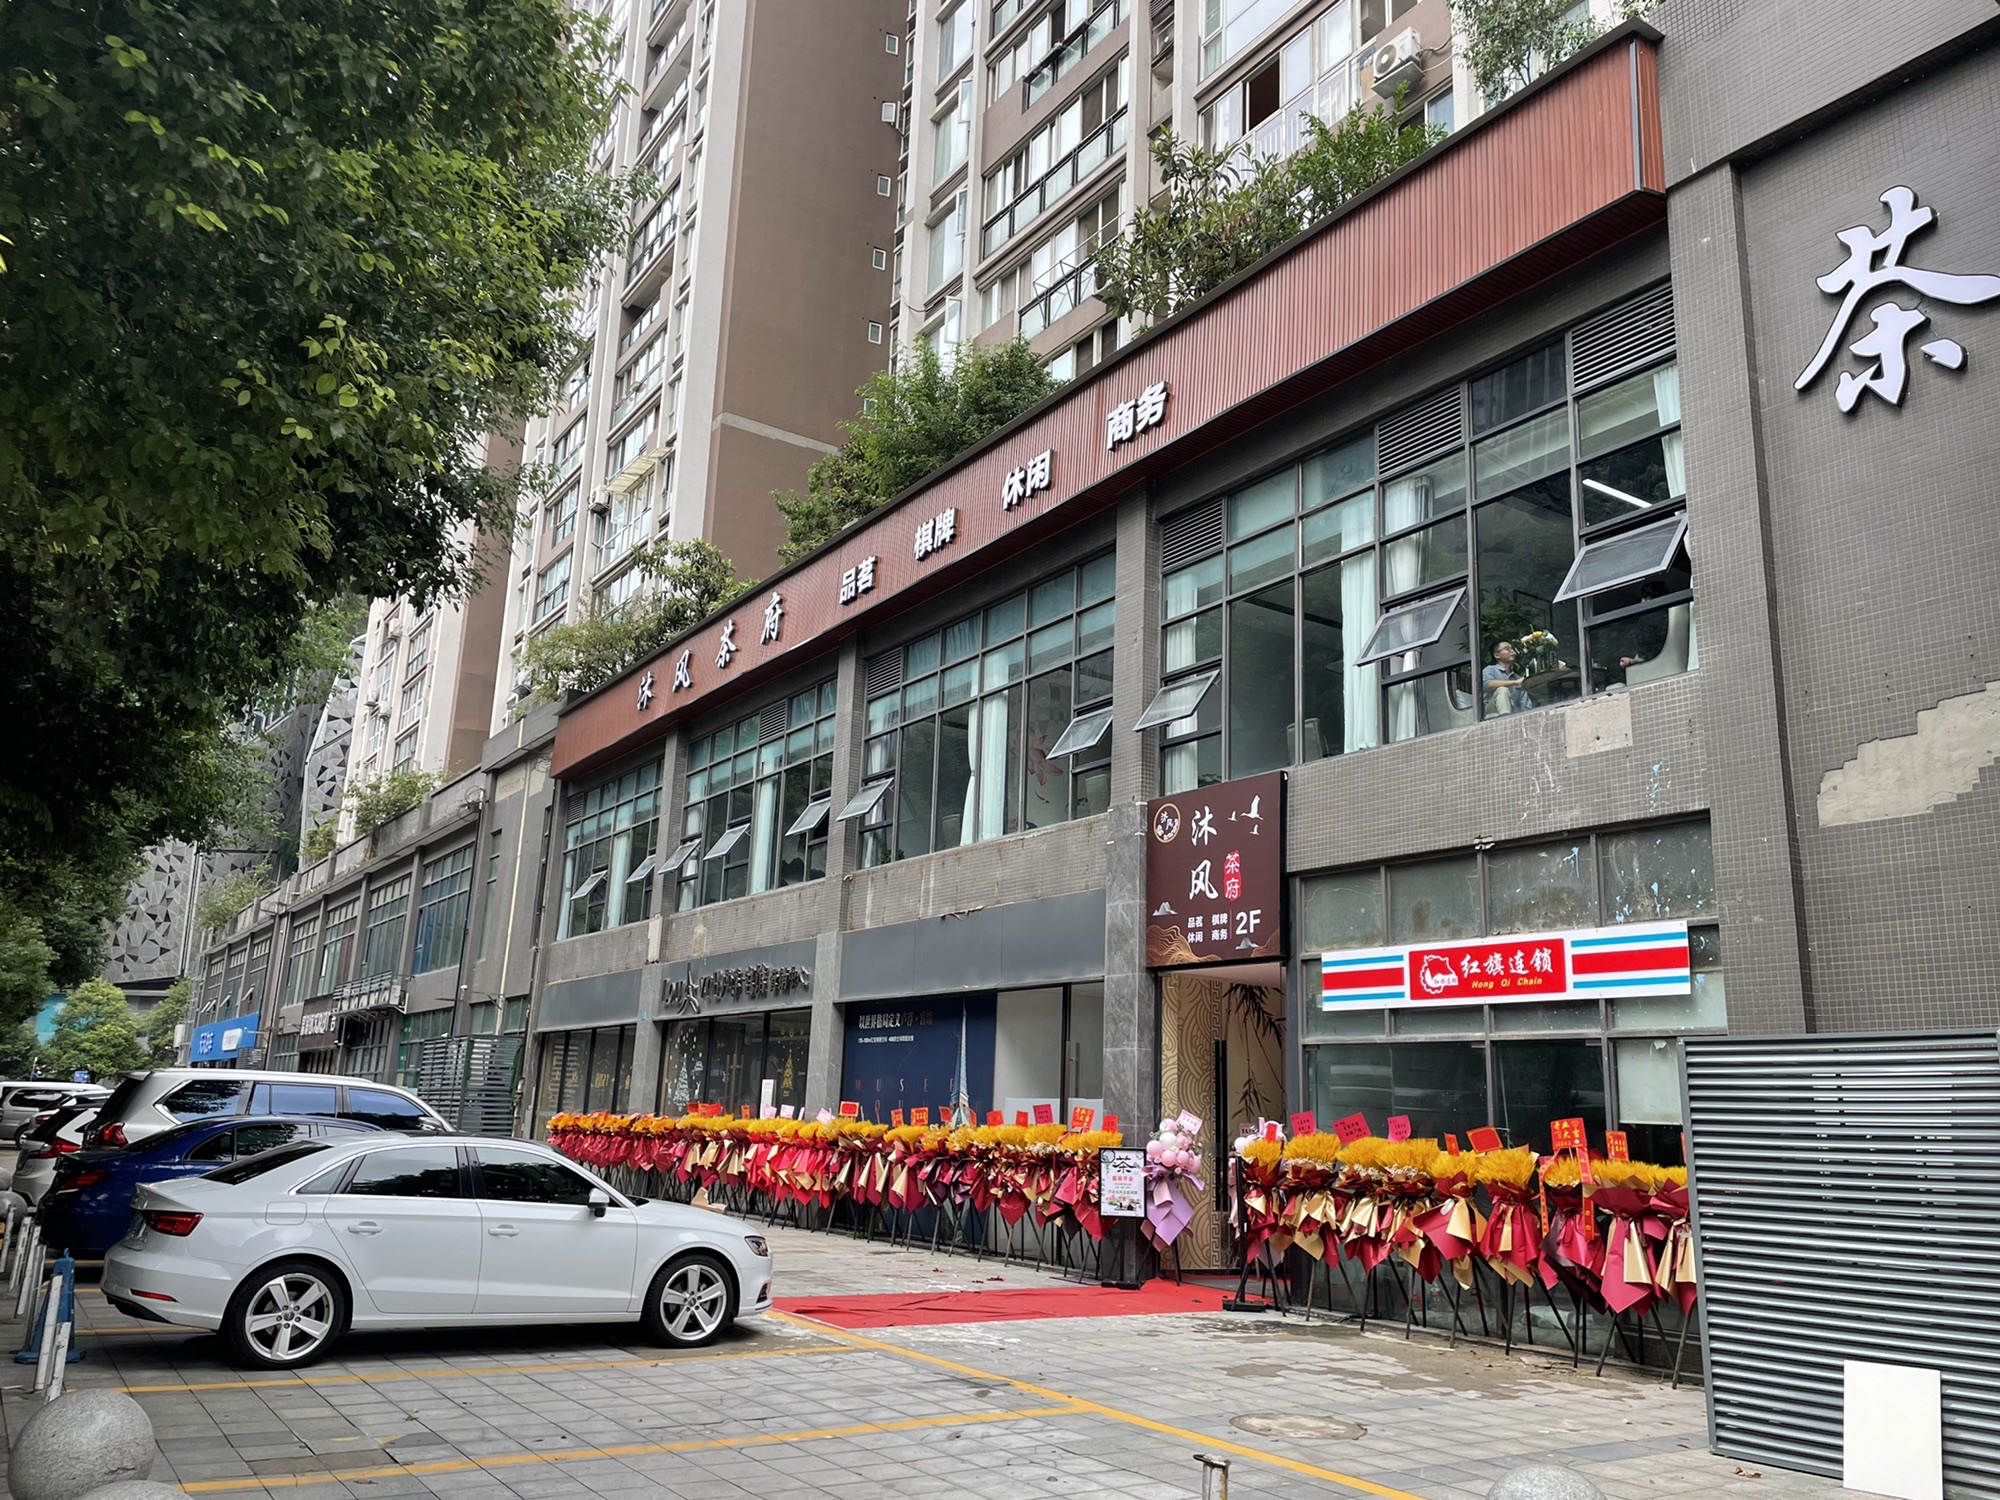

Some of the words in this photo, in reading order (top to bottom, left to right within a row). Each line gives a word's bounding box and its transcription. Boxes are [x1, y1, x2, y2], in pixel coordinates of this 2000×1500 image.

[1793, 185, 2000, 413] 茶
[636, 591, 784, 711] 沐风茶府
[839, 555, 879, 605] 品茗
[913, 506, 959, 561] 棋牌
[1001, 448, 1055, 511] 休闲
[1106, 380, 1170, 452] 商务
[1189, 805, 1219, 901] 沐风
[1224, 852, 1241, 899] 茶府
[1187, 915, 1204, 929] 品茗
[1211, 912, 1228, 926] 棋牌
[1235, 909, 1262, 936] 2F
[1187, 931, 1204, 944] 休闲
[1211, 928, 1228, 941] 商务
[1460, 947, 1554, 979] 红旗连锁
[1471, 980, 1494, 989] Hong
[1501, 978, 1511, 987] Qi
[1517, 976, 1543, 986] Chain
[1111, 1155, 1137, 1174] 茶
